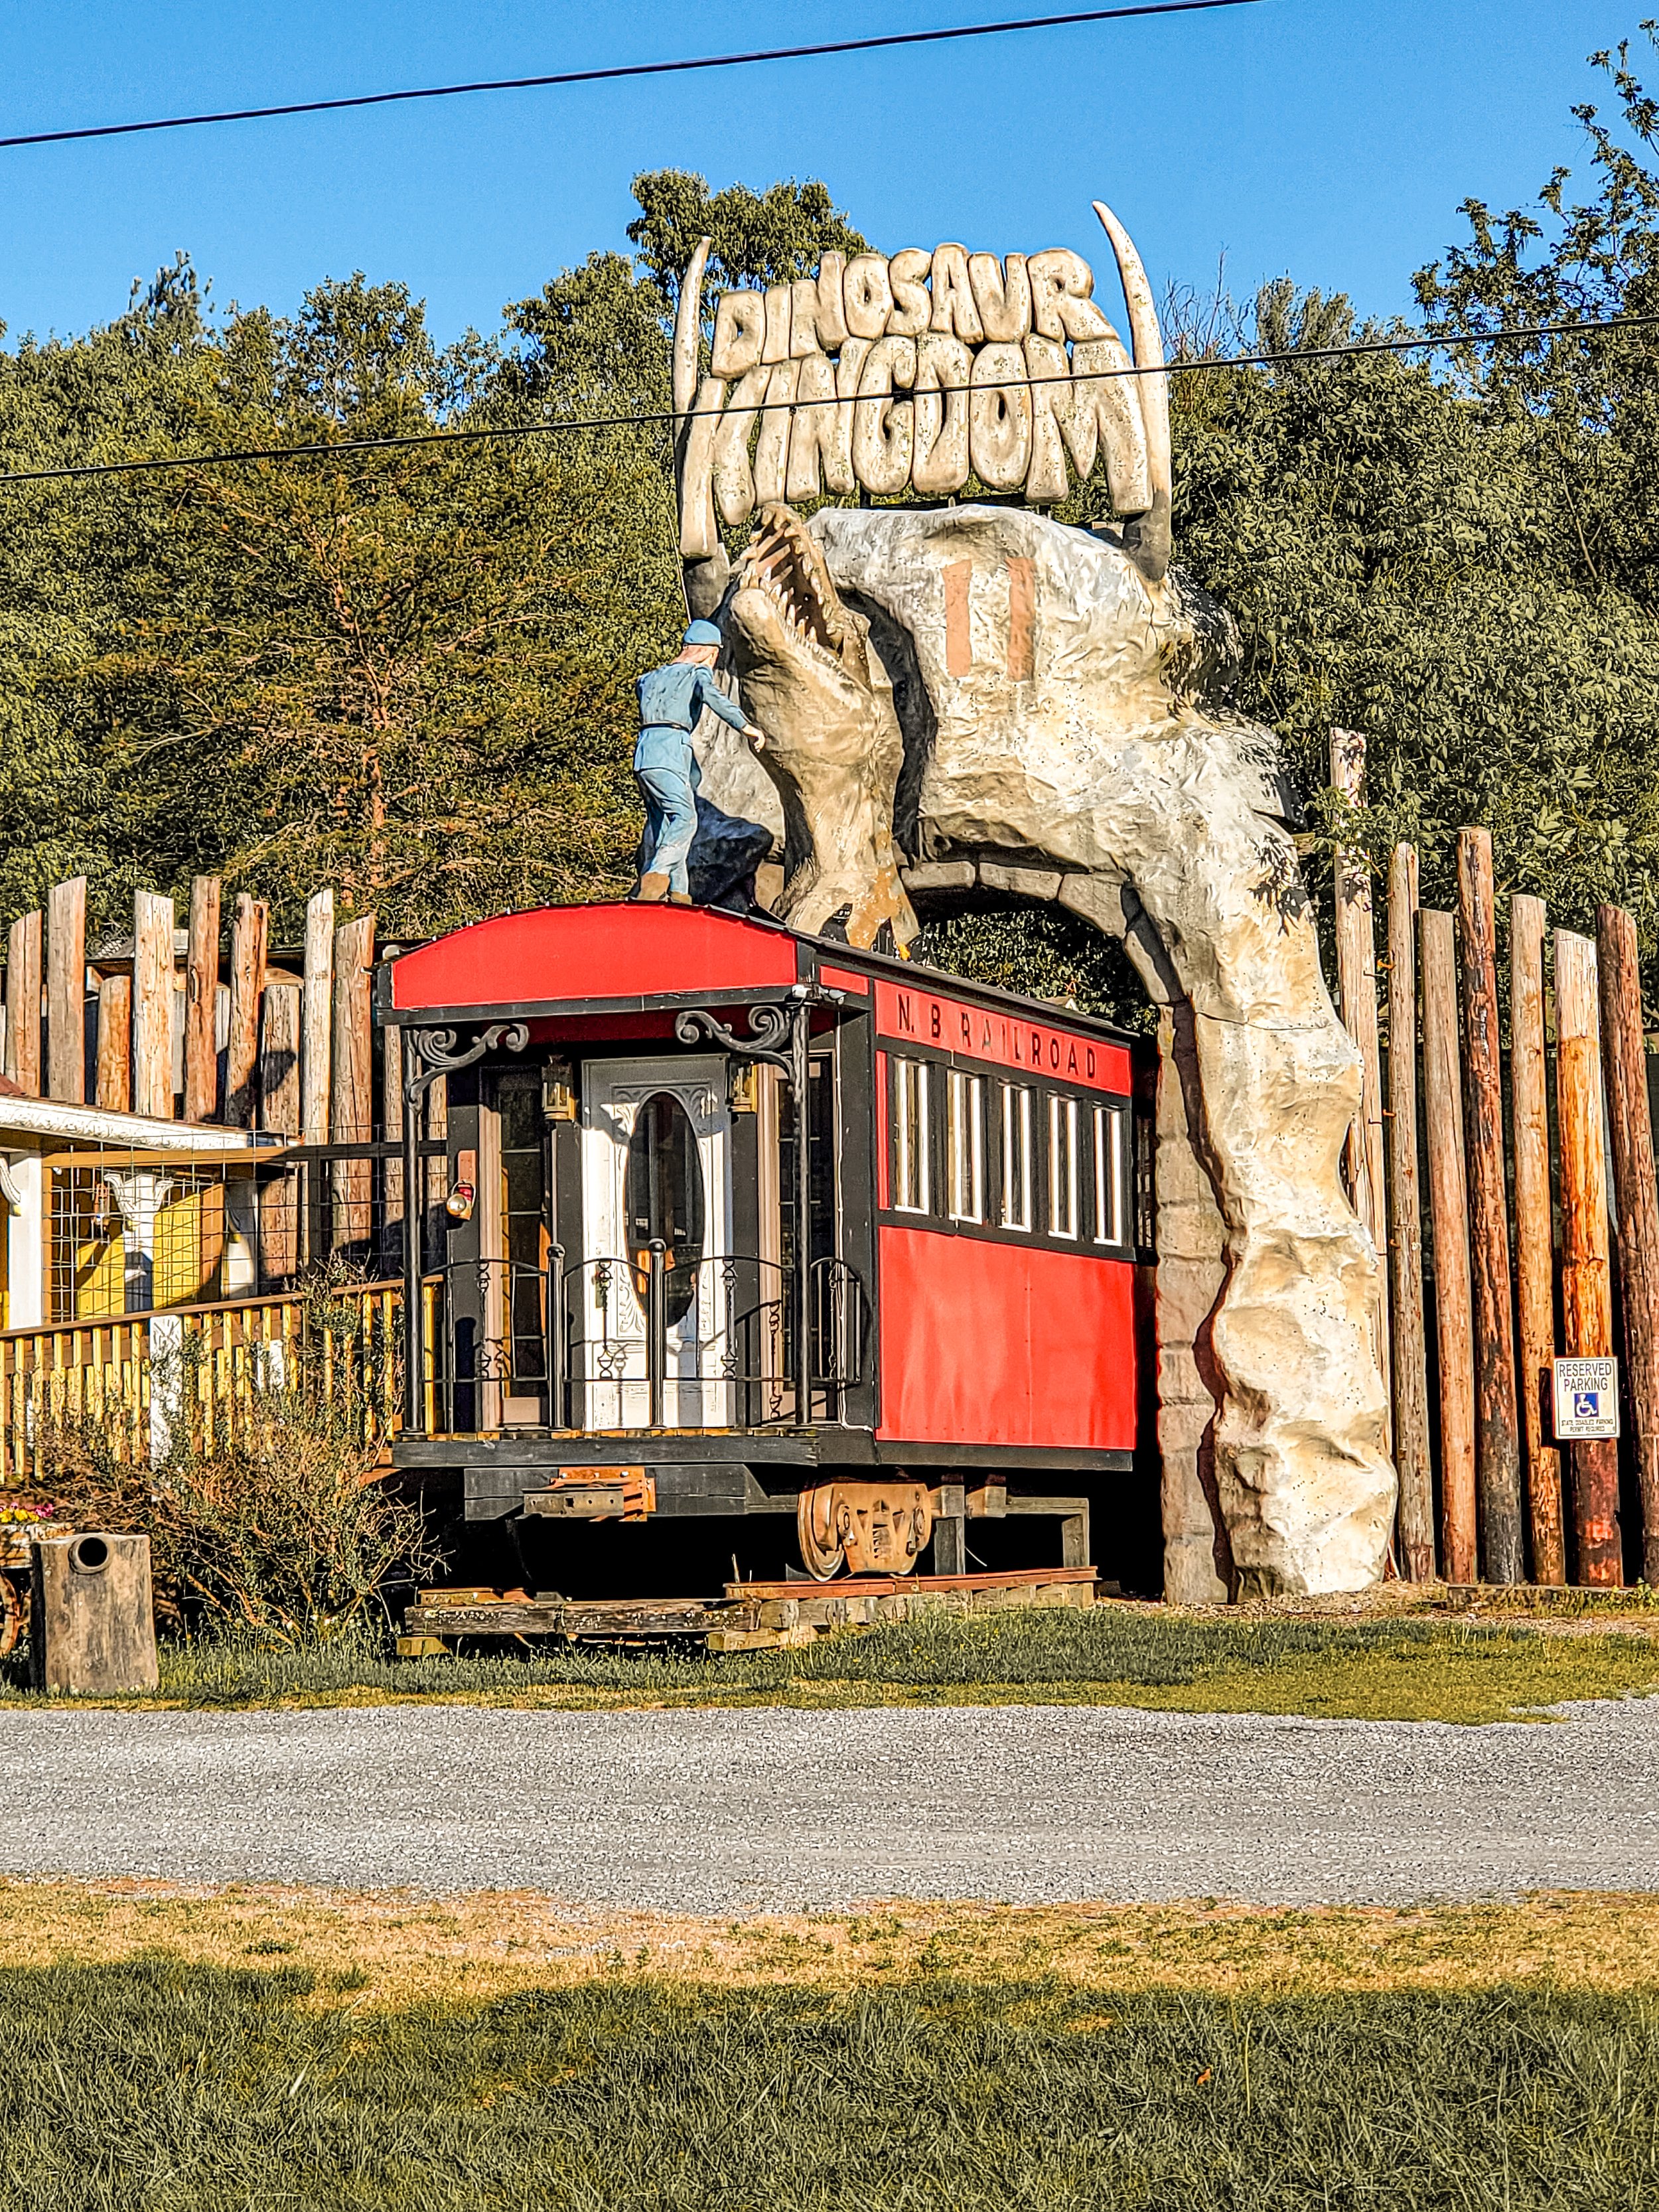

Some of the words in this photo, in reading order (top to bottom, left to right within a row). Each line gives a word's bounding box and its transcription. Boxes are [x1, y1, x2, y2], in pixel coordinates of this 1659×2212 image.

[711, 242, 1120, 379] DINOSAUR
[680, 332, 1153, 557] KINGDOM
[931, 1003, 942, 1039] B
[961, 1012, 1096, 1079] RAILROAD
[1559, 1363, 1612, 1377] RESERVED
[1564, 1377, 1608, 1392] PARKING
